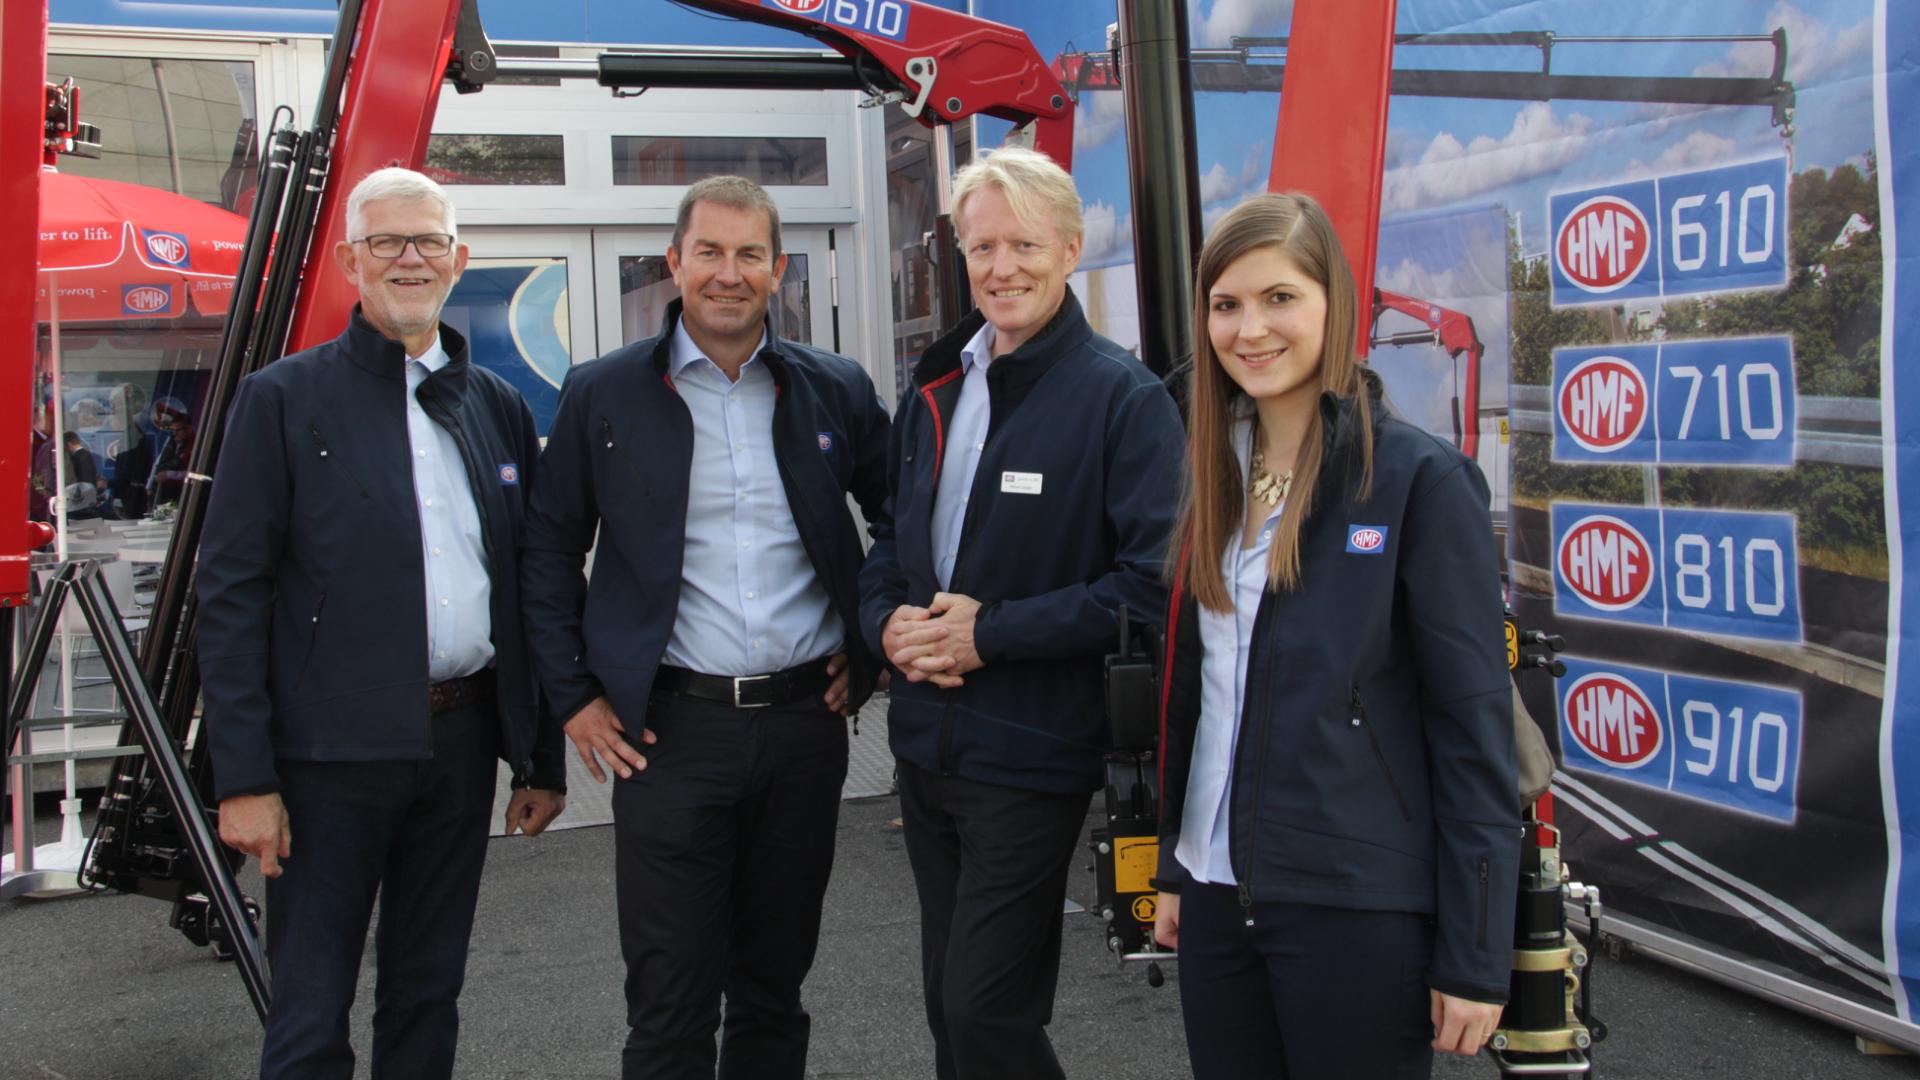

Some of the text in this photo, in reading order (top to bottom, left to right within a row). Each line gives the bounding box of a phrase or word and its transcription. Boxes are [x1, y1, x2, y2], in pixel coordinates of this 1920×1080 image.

[834, 0, 902, 36] 610
[61, 230, 79, 241] to
[212, 239, 245, 251] powe
[1567, 184, 1775, 280] HMF 610
[1570, 363, 1783, 440] HMF 710
[1355, 531, 1379, 547] HMF
[1570, 528, 1785, 616] HMF 810
[1576, 685, 1787, 792] HMF 910
